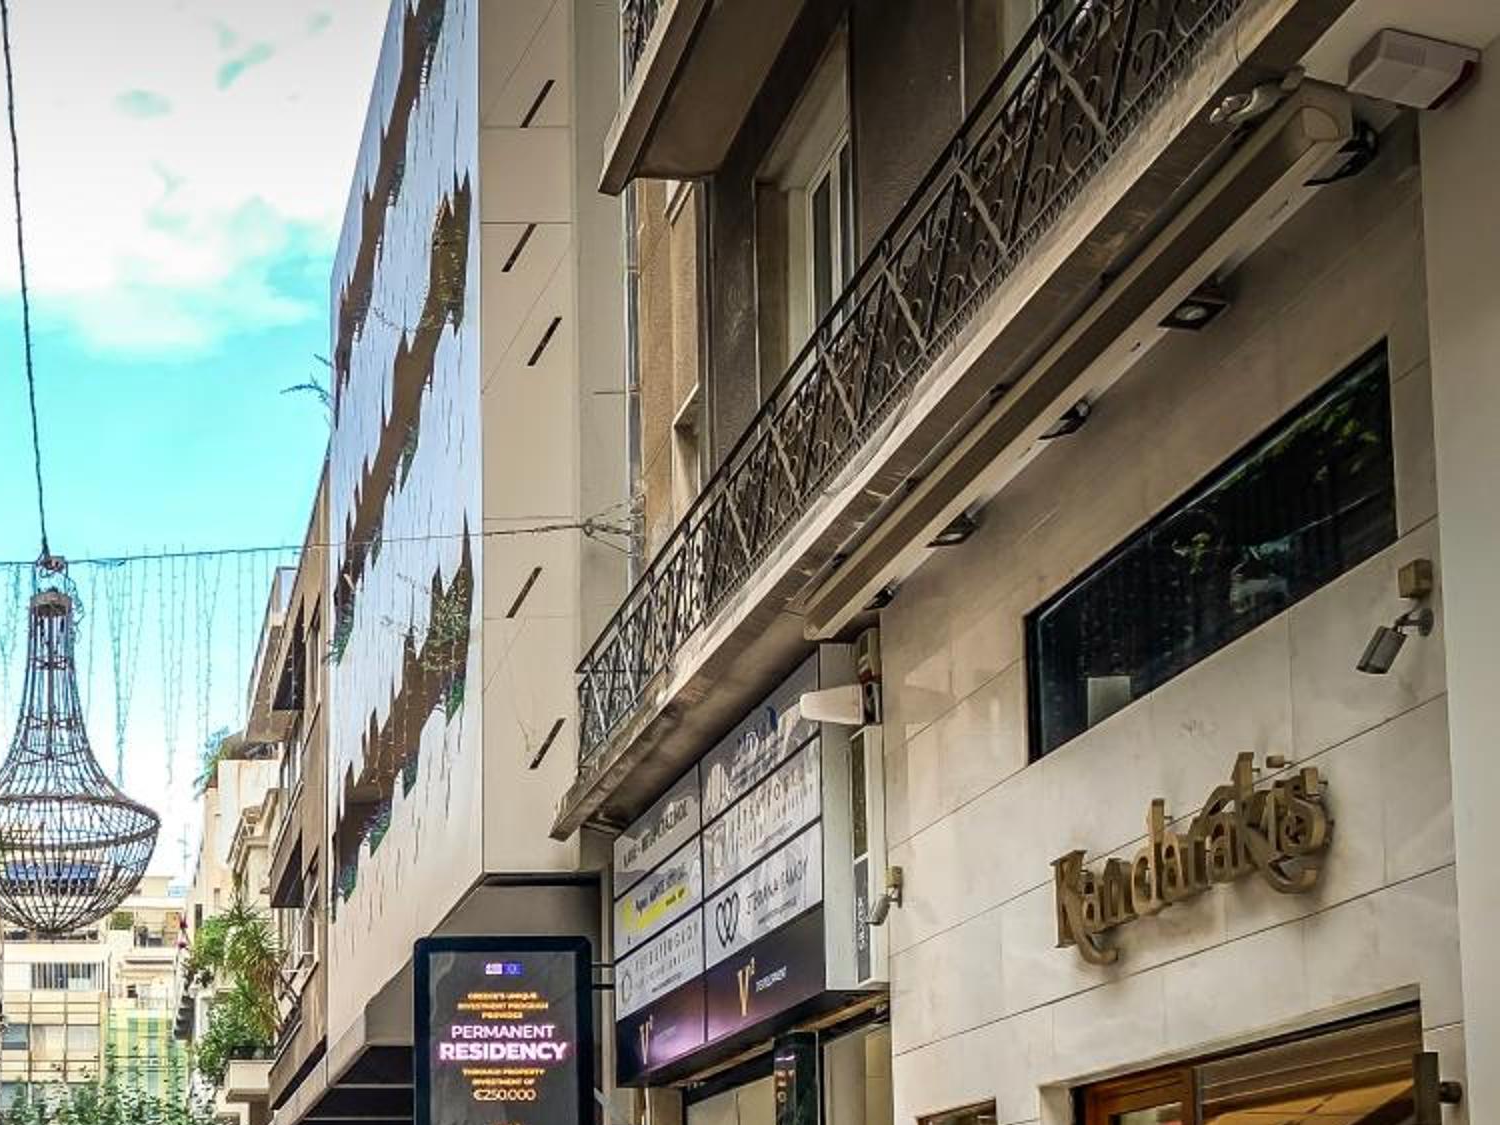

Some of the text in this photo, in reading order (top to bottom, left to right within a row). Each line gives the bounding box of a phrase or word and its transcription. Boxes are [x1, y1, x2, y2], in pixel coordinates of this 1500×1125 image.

[1050, 751, 1333, 966] Kandarakis
[451, 1025, 556, 1039] PERMANENT
[439, 1042, 567, 1060] RESIDENCY
[473, 1089, 537, 1101] €250.000
